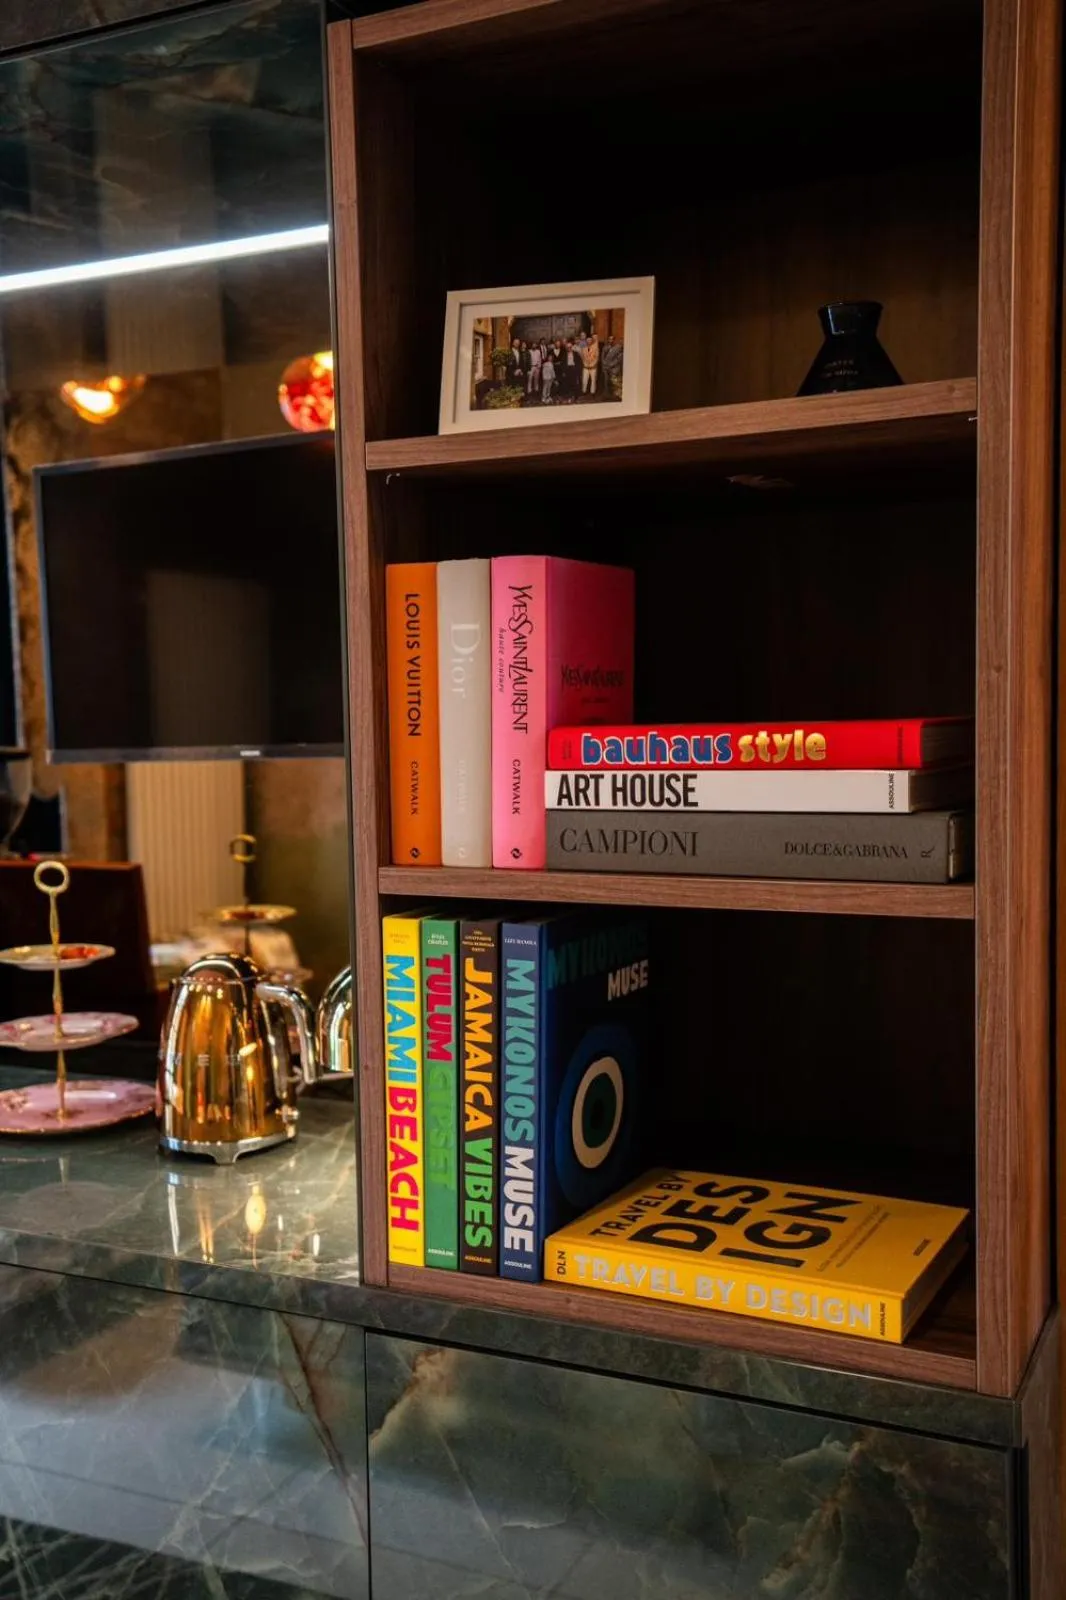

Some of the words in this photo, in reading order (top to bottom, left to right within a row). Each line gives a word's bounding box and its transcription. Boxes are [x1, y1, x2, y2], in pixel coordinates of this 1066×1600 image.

[405, 593, 420, 650] LOUIS
[405, 656, 421, 737] VUITTON
[450, 623, 480, 698] Dior
[581, 731, 734, 767] bauhaus
[737, 728, 828, 765] style
[411, 760, 420, 816] CATWALK
[511, 759, 521, 815] CATWALK
[556, 772, 605, 808] ART
[611, 772, 699, 808] HOUSE
[887, 773, 896, 809] ASSOULINE
[559, 826, 699, 857] CAMPIONI
[783, 840, 909, 859] DOLCE&GABBANA
[425, 953, 453, 1062] TULUM
[607, 959, 649, 1002] MUSE
[386, 954, 417, 1084] MIAMI
[464, 957, 493, 1131] JAMAICA
[503, 959, 536, 1143] MYKONOS
[388, 1087, 419, 1231] BEACH
[464, 1138, 493, 1249] VIBES
[503, 1145, 535, 1253] MUSE
[588, 1193, 670, 1237] TRAVEL
[656, 1175, 693, 1192] BY
[629, 1180, 772, 1253] DES
[719, 1191, 864, 1269] IGN
[556, 1250, 567, 1276] DLN
[574, 1254, 685, 1296] TRAVEL
[695, 1275, 736, 1304] BY
[744, 1283, 873, 1329] DESIGN
